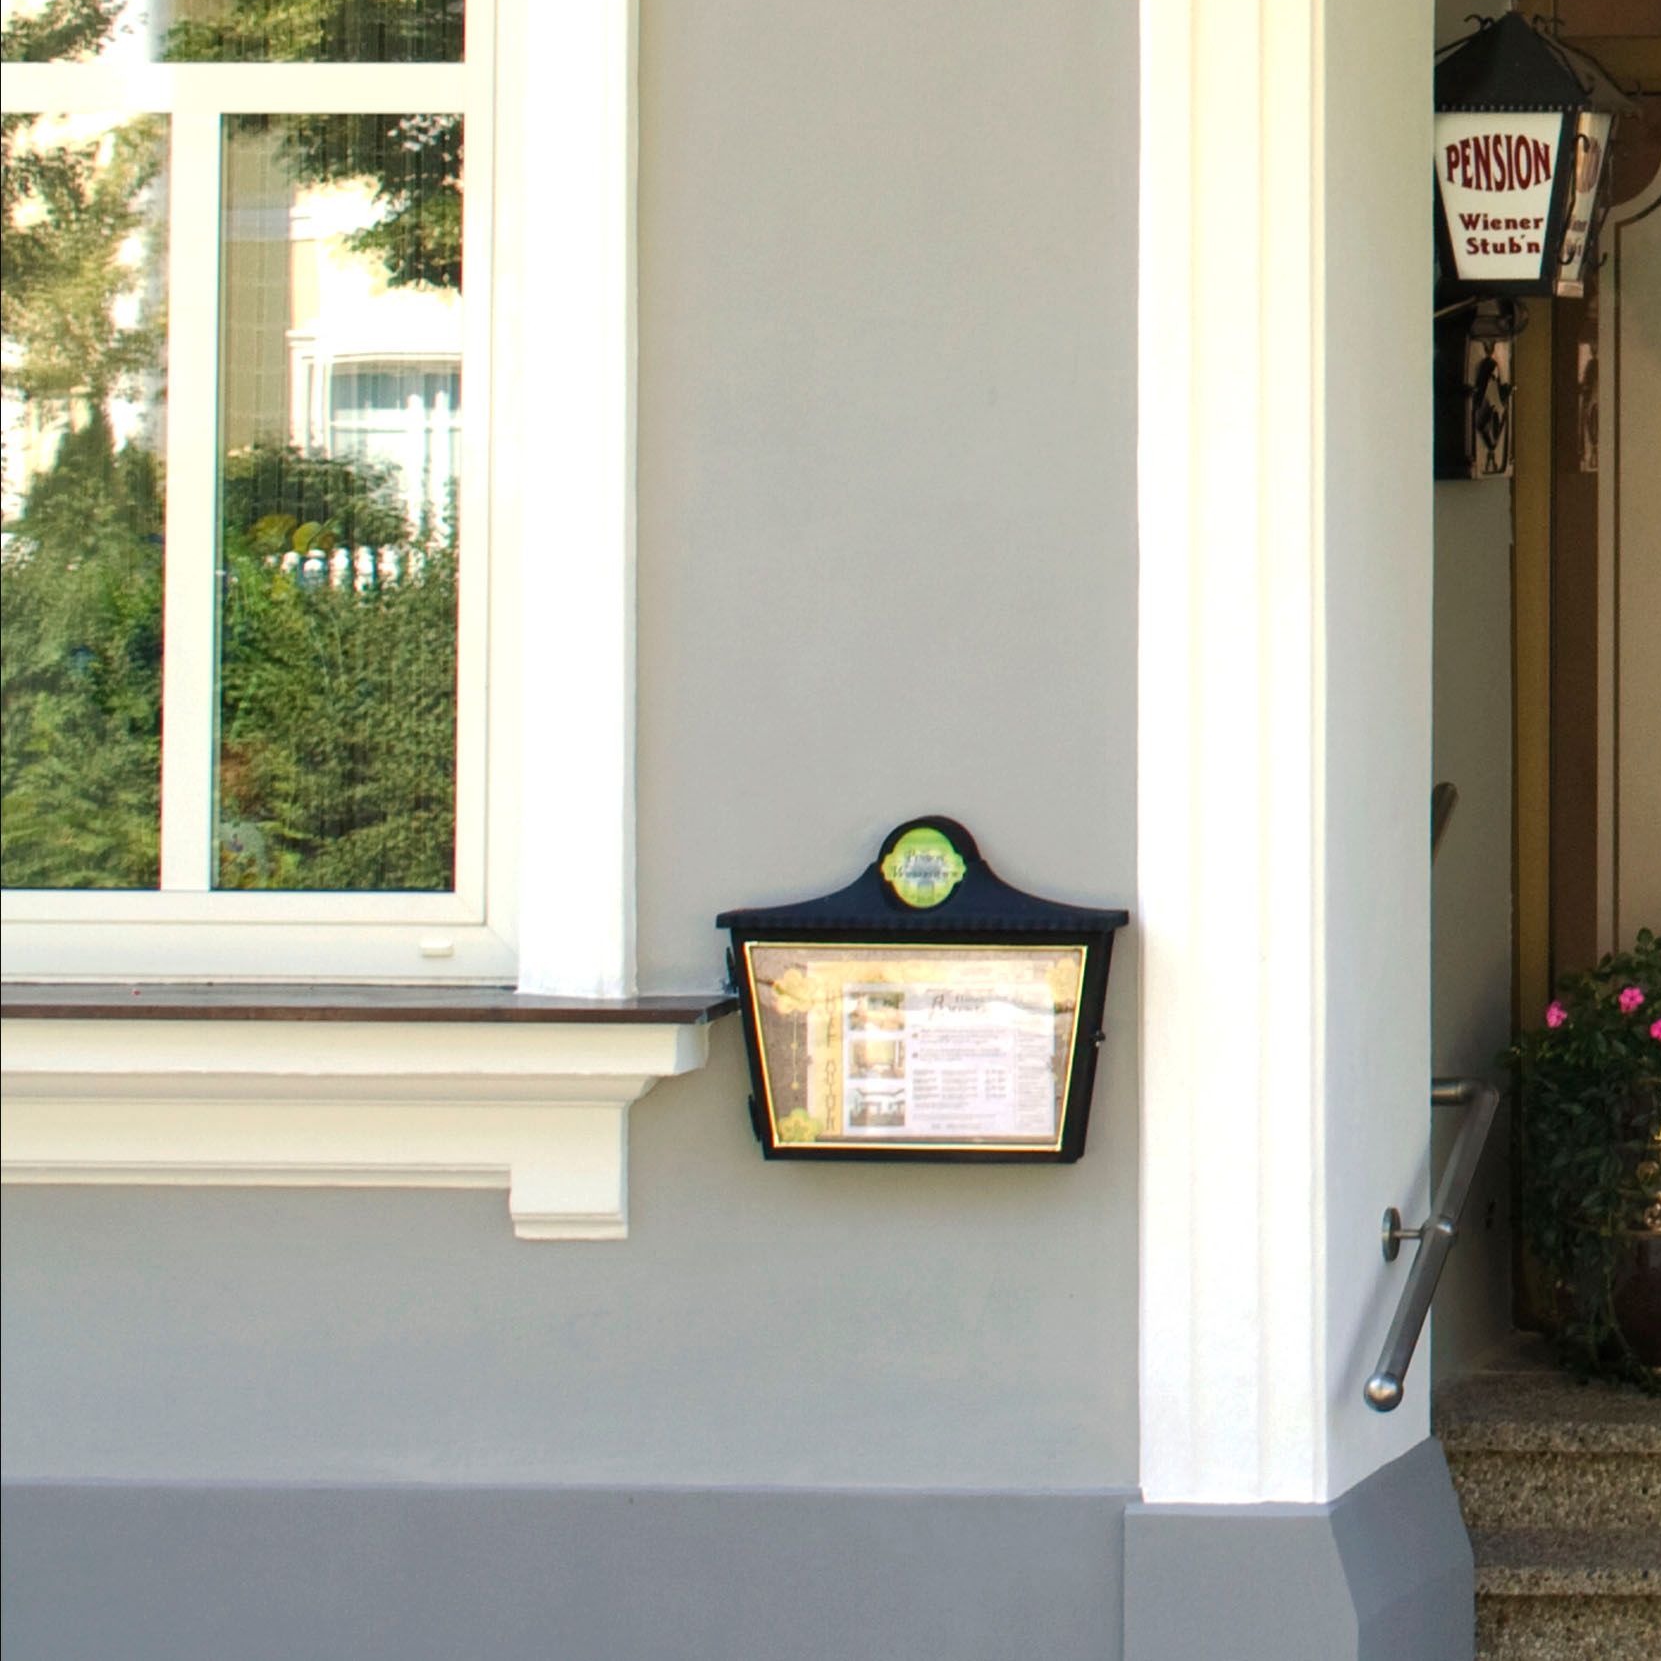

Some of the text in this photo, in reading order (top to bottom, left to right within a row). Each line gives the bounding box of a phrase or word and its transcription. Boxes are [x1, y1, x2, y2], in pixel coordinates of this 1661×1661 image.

[1445, 134, 1551, 192] PENSION
[1459, 213, 1544, 231] Wiener
[1466, 234, 1541, 255] Stub'n
